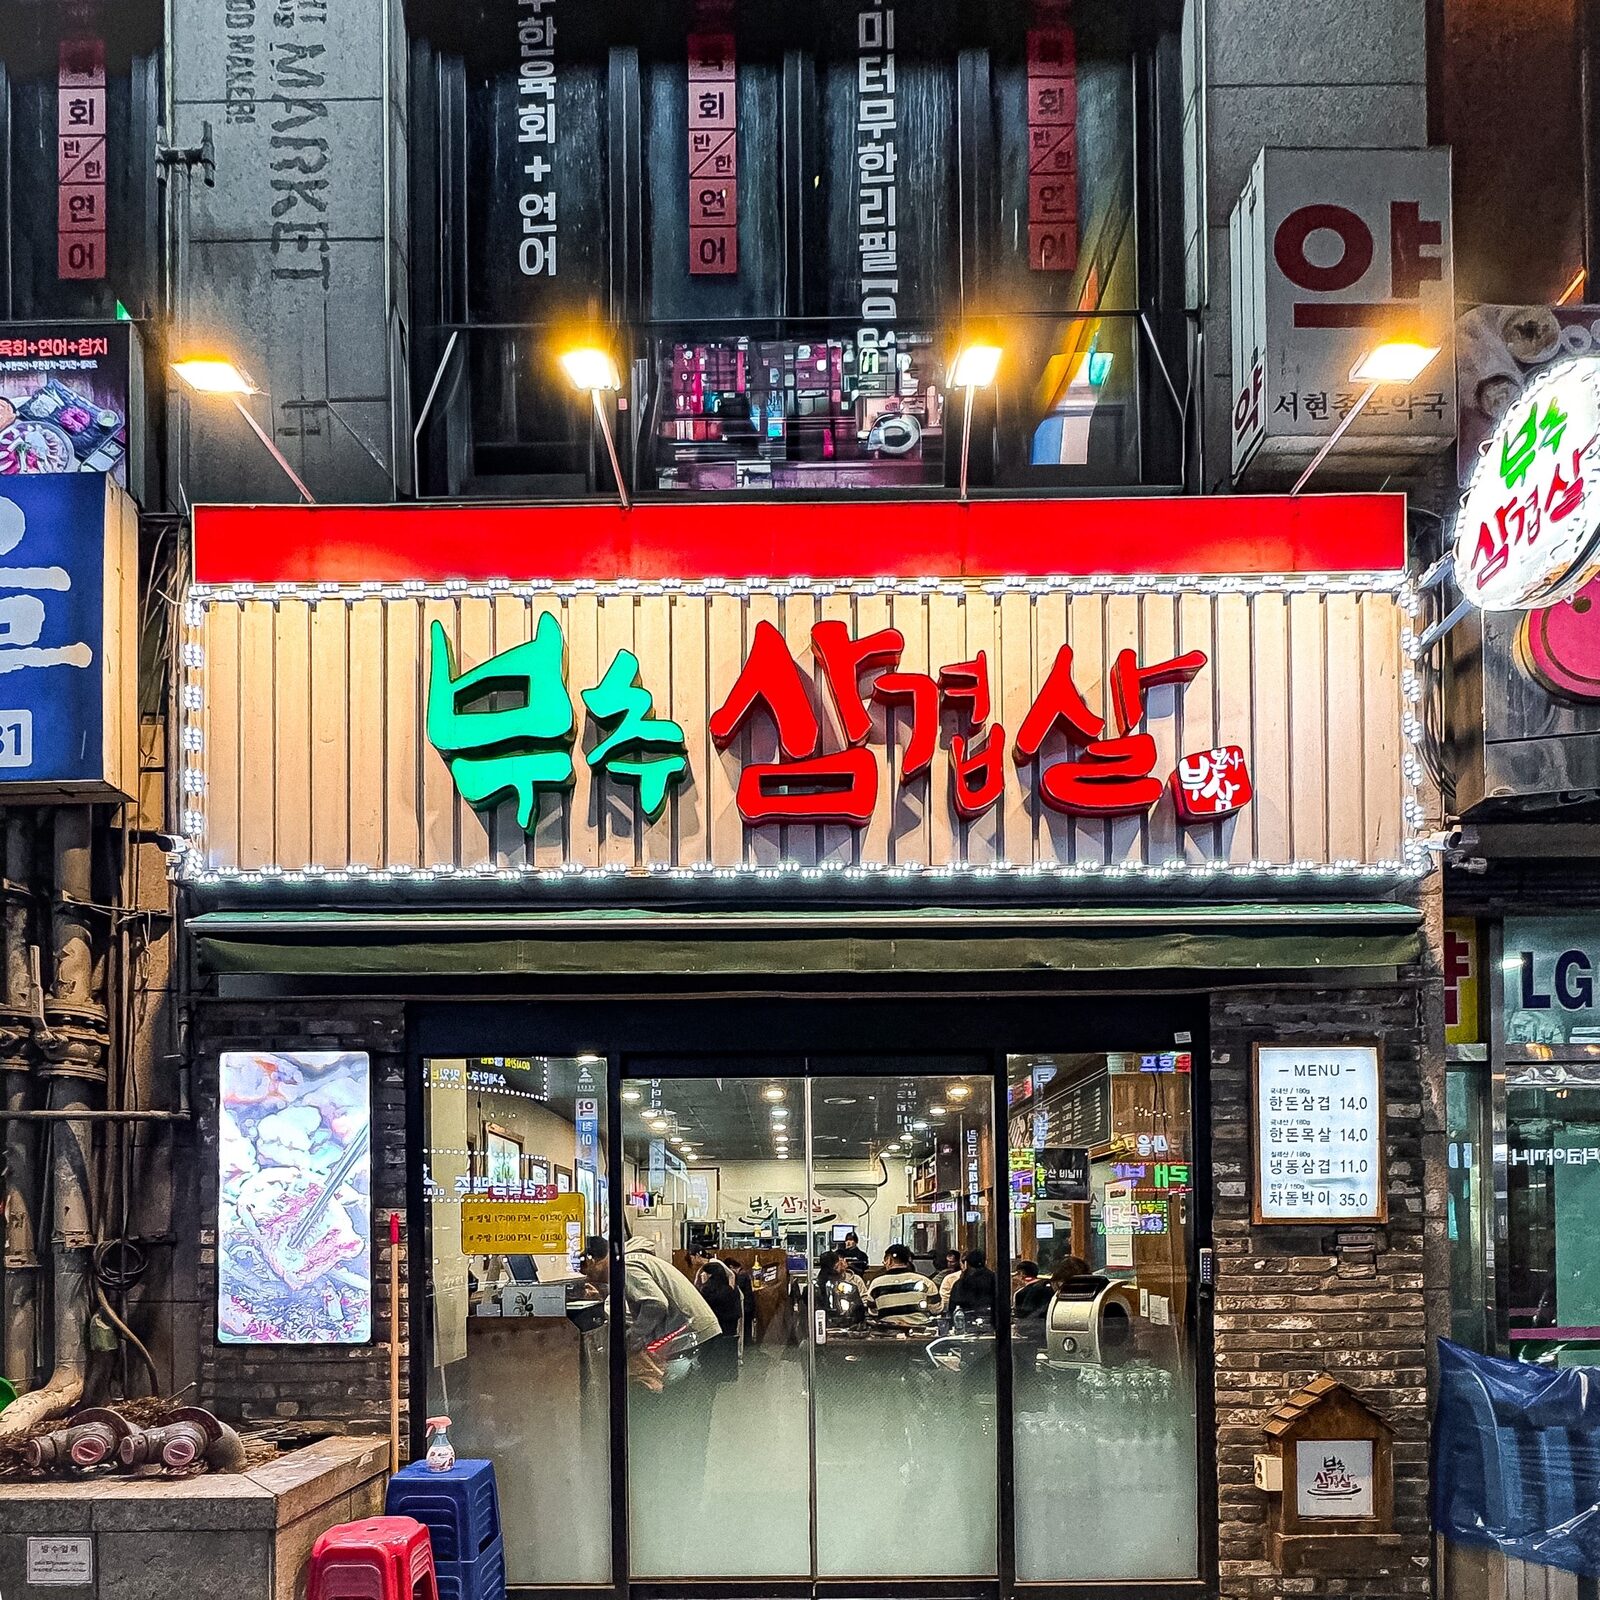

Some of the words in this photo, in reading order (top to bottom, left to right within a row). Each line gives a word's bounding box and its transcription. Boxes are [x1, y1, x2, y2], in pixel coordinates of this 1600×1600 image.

[270, 43, 331, 292] MARKET
[517, 193, 558, 277] 연어
[1272, 390, 1449, 423] 서현종로약국
[1500, 396, 1568, 490] 부추
[1470, 434, 1599, 591] 삼겹살
[428, 610, 688, 836] 부추
[711, 619, 1208, 828] 삼겹살
[1521, 949, 1593, 1011] LG
[1294, 1064, 1340, 1077] MENU
[1269, 1096, 1331, 1112] 한돈삼겹
[1339, 1096, 1368, 1111] 14.0
[1269, 1127, 1332, 1143] 한돈목살
[1340, 1128, 1368, 1142] 14.0
[1270, 1159, 1332, 1175] 냉동삼겹
[1340, 1159, 1368, 1174] 11.0
[749, 1196, 773, 1214] 부추
[1269, 1190, 1331, 1206] 차돌박이
[1339, 1193, 1368, 1207] 35.0
[494, 1214, 517, 1223] 17:00
[518, 1214, 531, 1223] PM
[494, 1234, 517, 1242] 12:00
[518, 1234, 531, 1242] PM
[1323, 1455, 1346, 1473] 부추
[1314, 1471, 1356, 1489] 삼겹살
